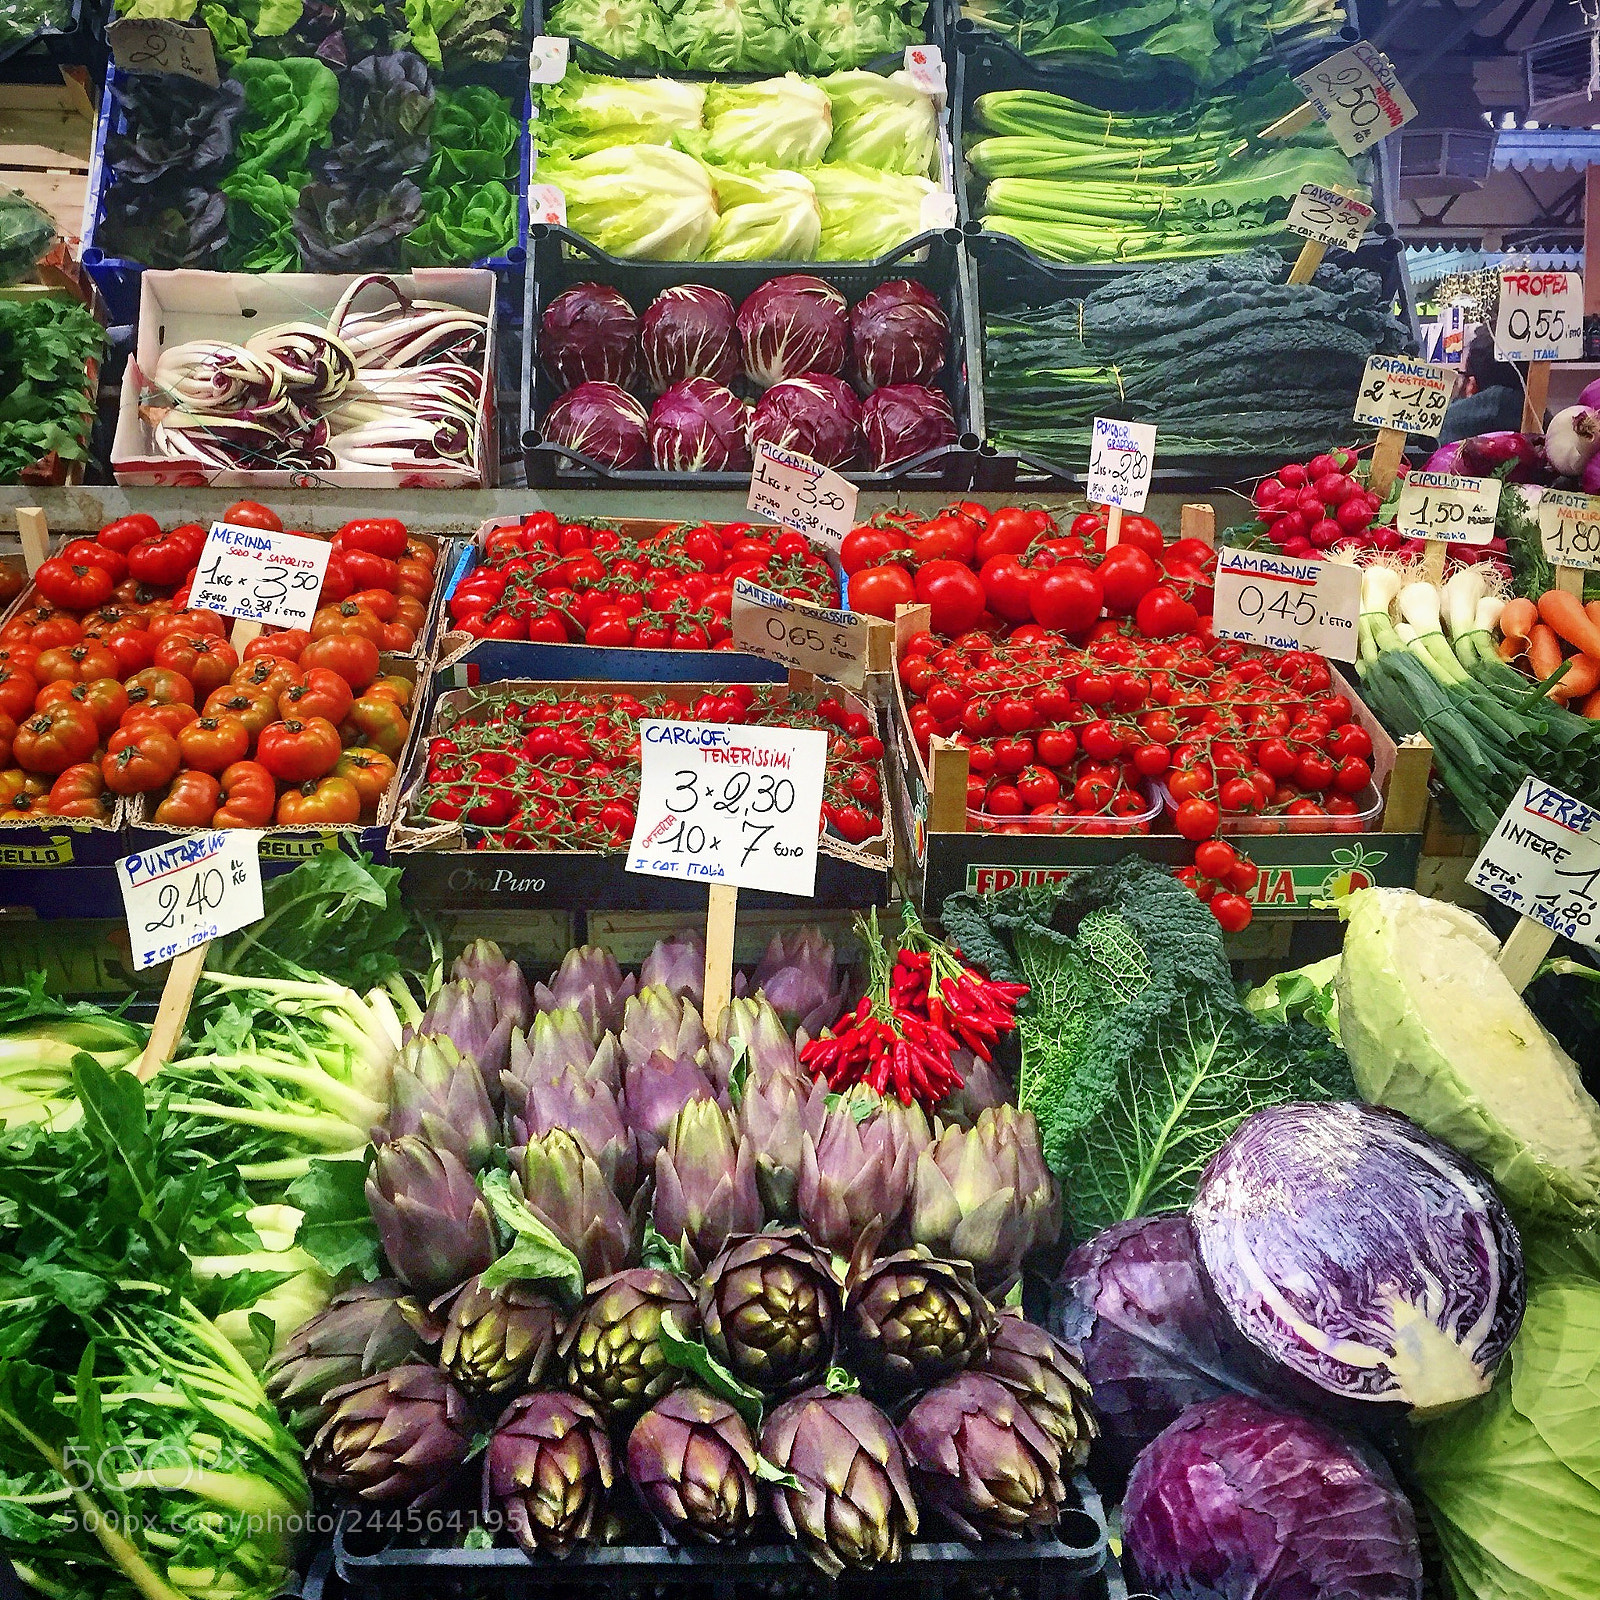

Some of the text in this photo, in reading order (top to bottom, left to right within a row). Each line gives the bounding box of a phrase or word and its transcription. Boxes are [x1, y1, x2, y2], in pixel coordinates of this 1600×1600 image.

[1300, 184, 1344, 206] CAVOLO
[1301, 198, 1359, 230] 3,50
[1503, 274, 1568, 296] TROPEA
[1508, 308, 1566, 343] 0,55
[1371, 357, 1443, 381] RAPANELLI
[1363, 380, 1385, 402] 2
[760, 442, 826, 484] PICCADILLY
[797, 479, 845, 511] 3,50
[1409, 472, 1482, 490] CIPOLLOTTI
[1410, 496, 1465, 528] 1,50
[1542, 491, 1589, 510] CAROTE
[212, 527, 273, 551] MERINDA
[267, 555, 315, 570] SAPORITO
[1220, 551, 1322, 580] LAMPADINE
[253, 566, 320, 605] 3,50
[737, 579, 796, 613] DATTERINO
[240, 597, 273, 614] 0,38
[1238, 585, 1318, 626] 0,45
[766, 617, 826, 652] 0,65
[666, 770, 698, 812] 3
[712, 770, 796, 817] 2,30
[0, 849, 60, 864] ELLO
[741, 820, 776, 868] 7
[1501, 818, 1572, 864] INTERE
[634, 858, 650, 870] I
[652, 860, 681, 873] CAT.
[145, 868, 225, 932] 2,40
